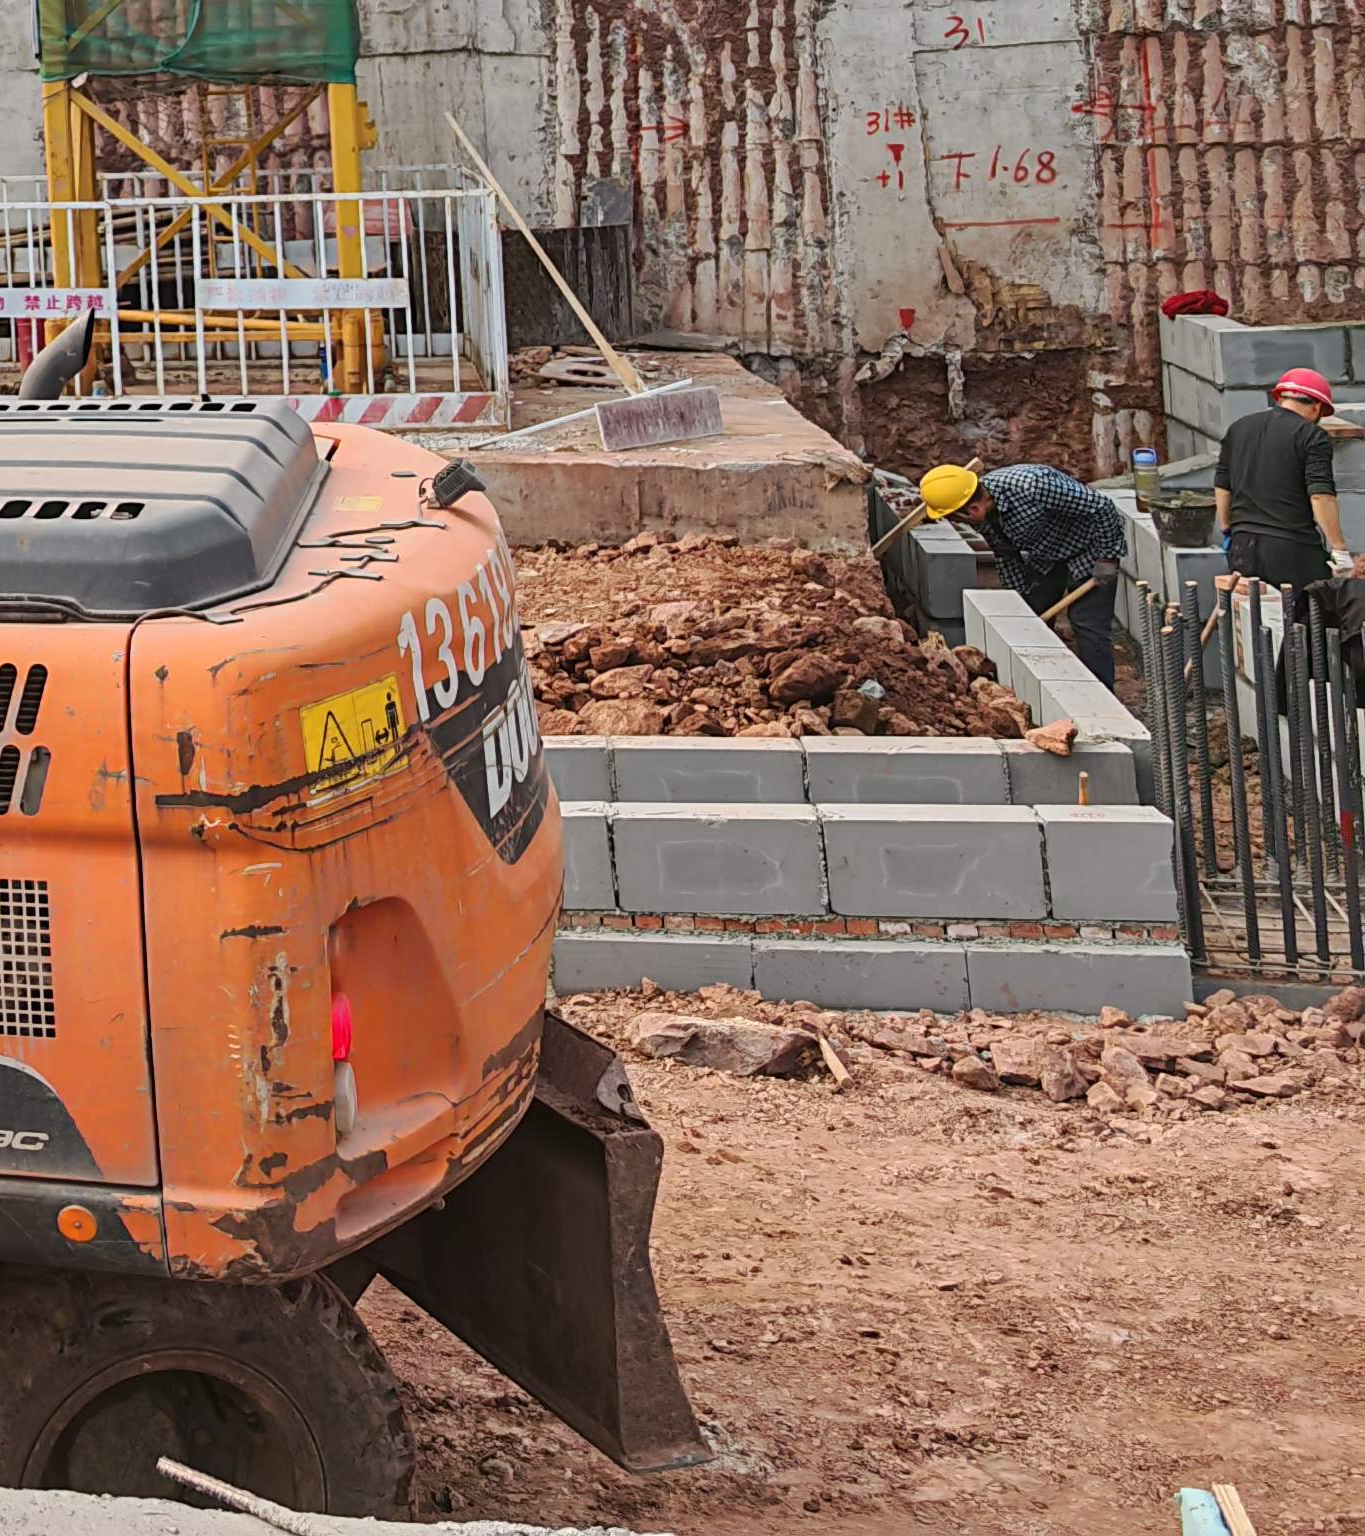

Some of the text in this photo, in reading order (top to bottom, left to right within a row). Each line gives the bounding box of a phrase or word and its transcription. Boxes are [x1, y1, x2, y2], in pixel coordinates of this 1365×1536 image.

[944, 16, 985, 50] 31
[24, 294, 105, 312] 禁止跨越
